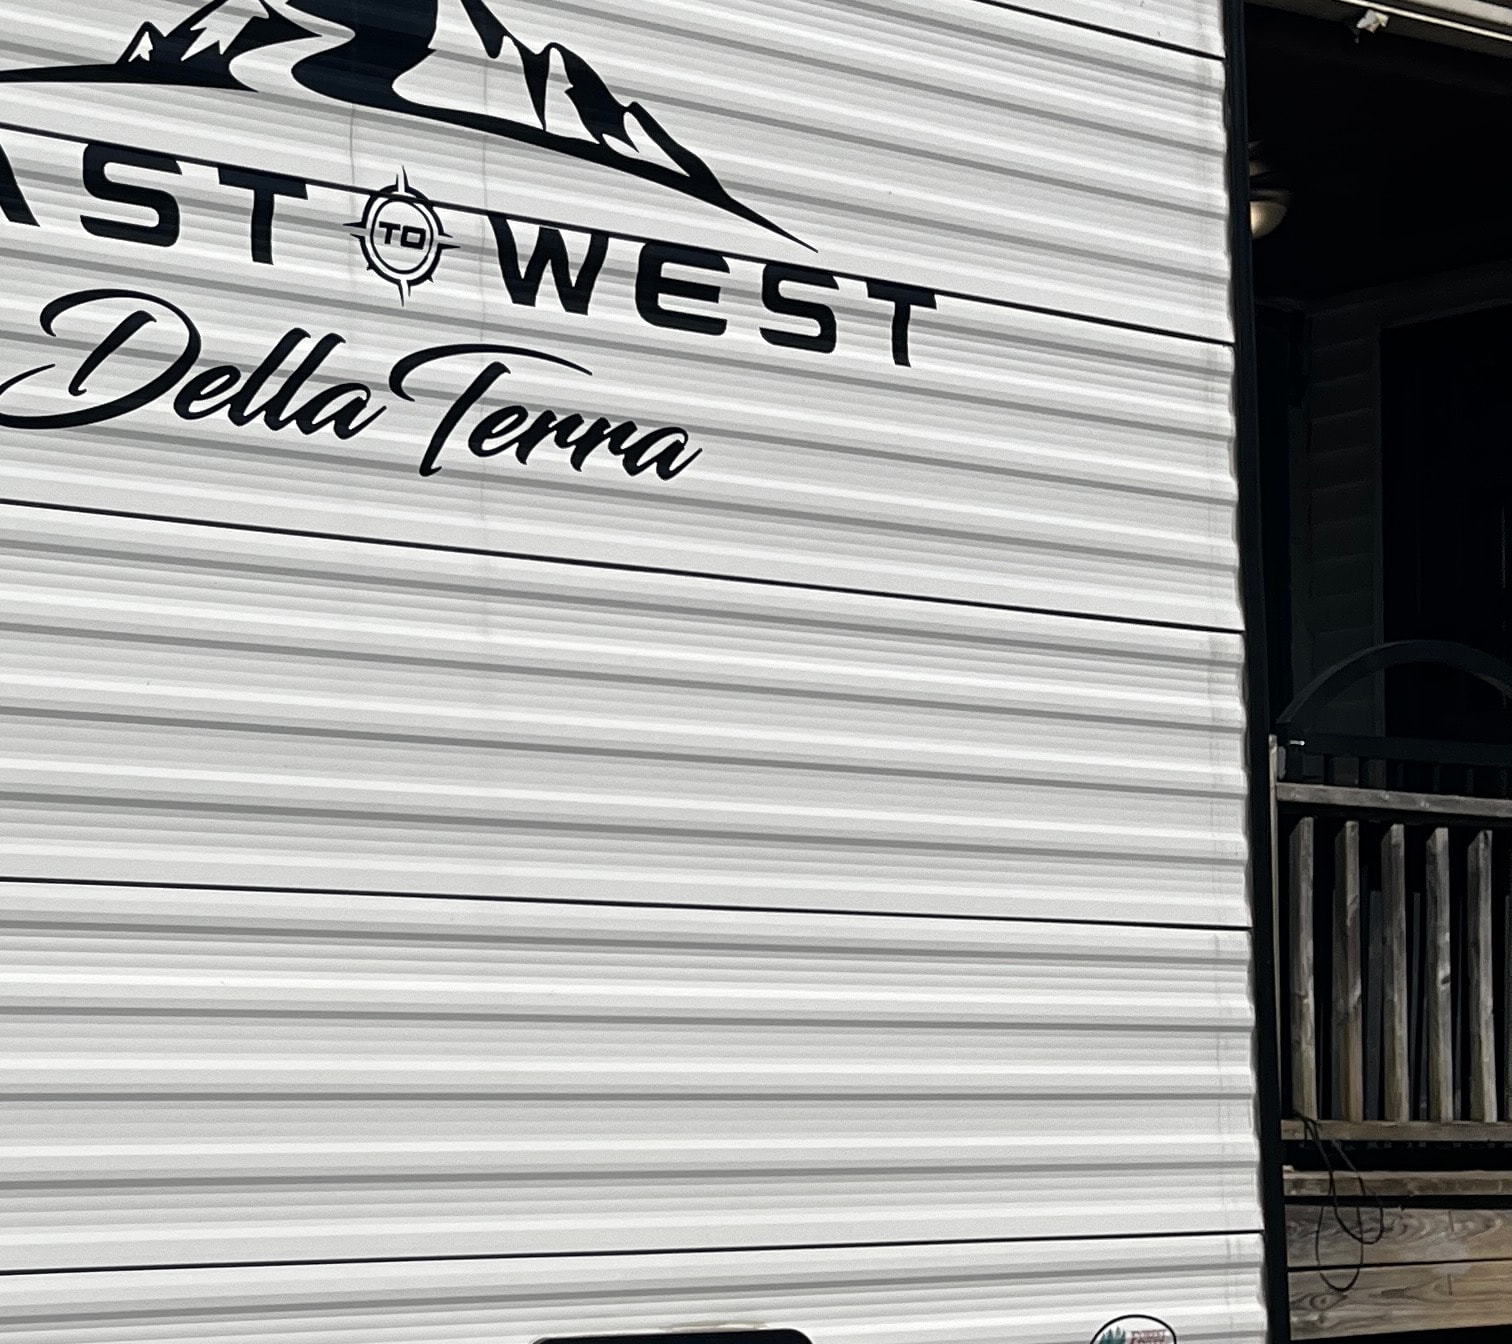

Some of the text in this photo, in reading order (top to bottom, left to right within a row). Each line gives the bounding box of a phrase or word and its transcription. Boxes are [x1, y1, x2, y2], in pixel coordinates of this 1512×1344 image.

[378, 220, 427, 250] TO
[489, 212, 938, 368] WEST
[389, 345, 702, 481] Terra
